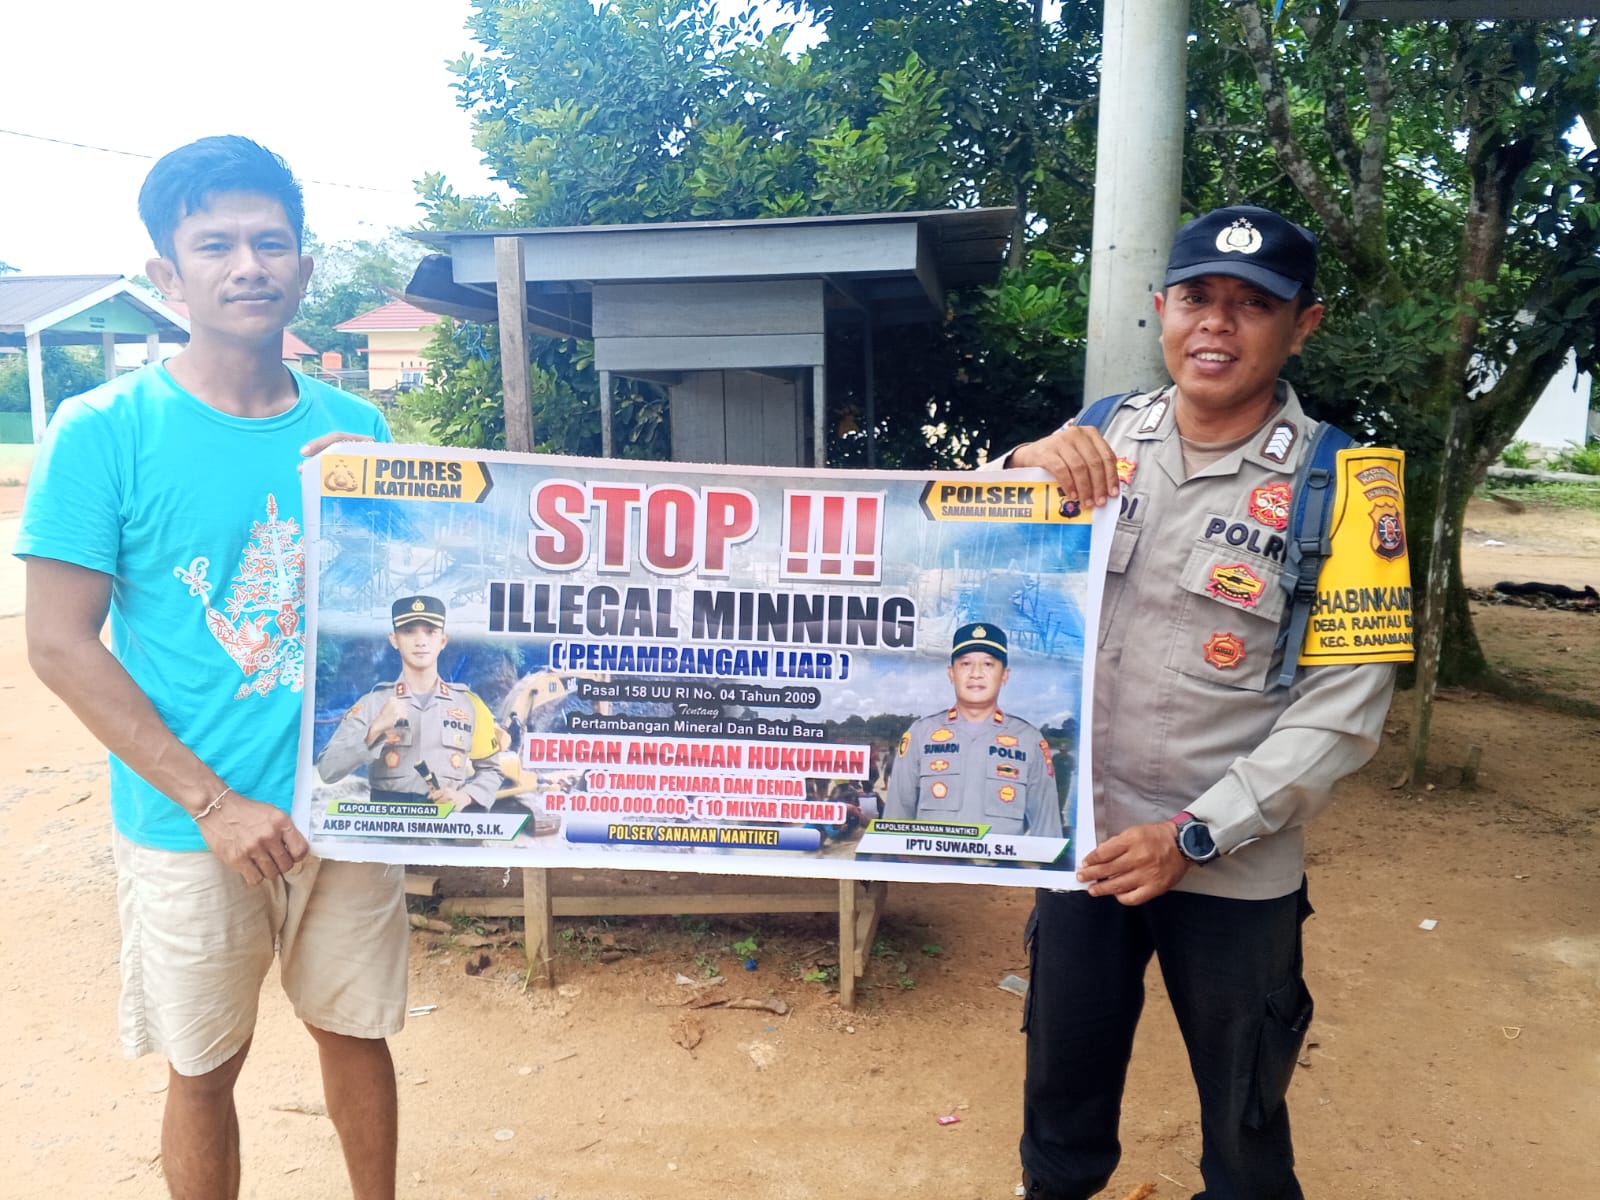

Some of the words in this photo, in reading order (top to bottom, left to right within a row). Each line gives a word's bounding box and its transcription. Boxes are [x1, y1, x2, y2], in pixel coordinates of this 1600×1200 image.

[376, 459, 462, 482] POLRES
[375, 481, 462, 498] KATINGAN
[941, 486, 1034, 504] POLSEK
[942, 505, 986, 517] SANAMAN
[535, 484, 754, 570] STOP
[787, 495, 878, 576] !!!
[489, 582, 678, 638] ILLEGAL
[691, 590, 915, 648] MINNING
[583, 684, 620, 697] Pasal
[624, 686, 647, 698] 158
[651, 686, 671, 698] UU
[676, 687, 689, 699] RI
[693, 688, 716, 700] No.
[720, 689, 735, 700] 04
[739, 689, 780, 702] Tahun
[784, 691, 816, 704] 2009
[679, 703, 720, 718] Tentang
[572, 717, 669, 733] Pertambangan
[674, 720, 723, 733] Mineral
[727, 722, 753, 735] Dan
[757, 723, 788, 736] Batu
[793, 725, 824, 738] Bara
[529, 738, 622, 764] DENGAN
[627, 742, 742, 769] ANCAMAN
[748, 746, 864, 774] HUKUMAN
[989, 745, 1027, 762] POLRI
[589, 773, 605, 789] 10
[609, 773, 656, 791] TAHUN
[659, 775, 720, 793] PENJARA
[724, 777, 753, 795] DAN
[757, 778, 804, 797] DENDA
[339, 803, 387, 814] KAPOLRES
[389, 805, 438, 816] KATINGAN
[545, 794, 566, 811] RP.
[726, 800, 776, 818] MILYAR
[323, 819, 351, 831] AKBP
[354, 821, 404, 833] CHANDRA
[407, 823, 474, 837] ISMAWANTO,
[477, 824, 504, 836] S.I.K.
[609, 825, 654, 841] POLSEK
[658, 827, 717, 843] SANAMAN
[720, 829, 779, 846] MANTIKEI
[875, 823, 909, 832] KAPOLSEK
[911, 825, 943, 833] SANAMAN
[945, 827, 978, 836] MANTIKEI
[906, 838, 932, 851] IPTU
[935, 841, 991, 857] SUWARDI,
[994, 844, 1017, 856] S.H.
